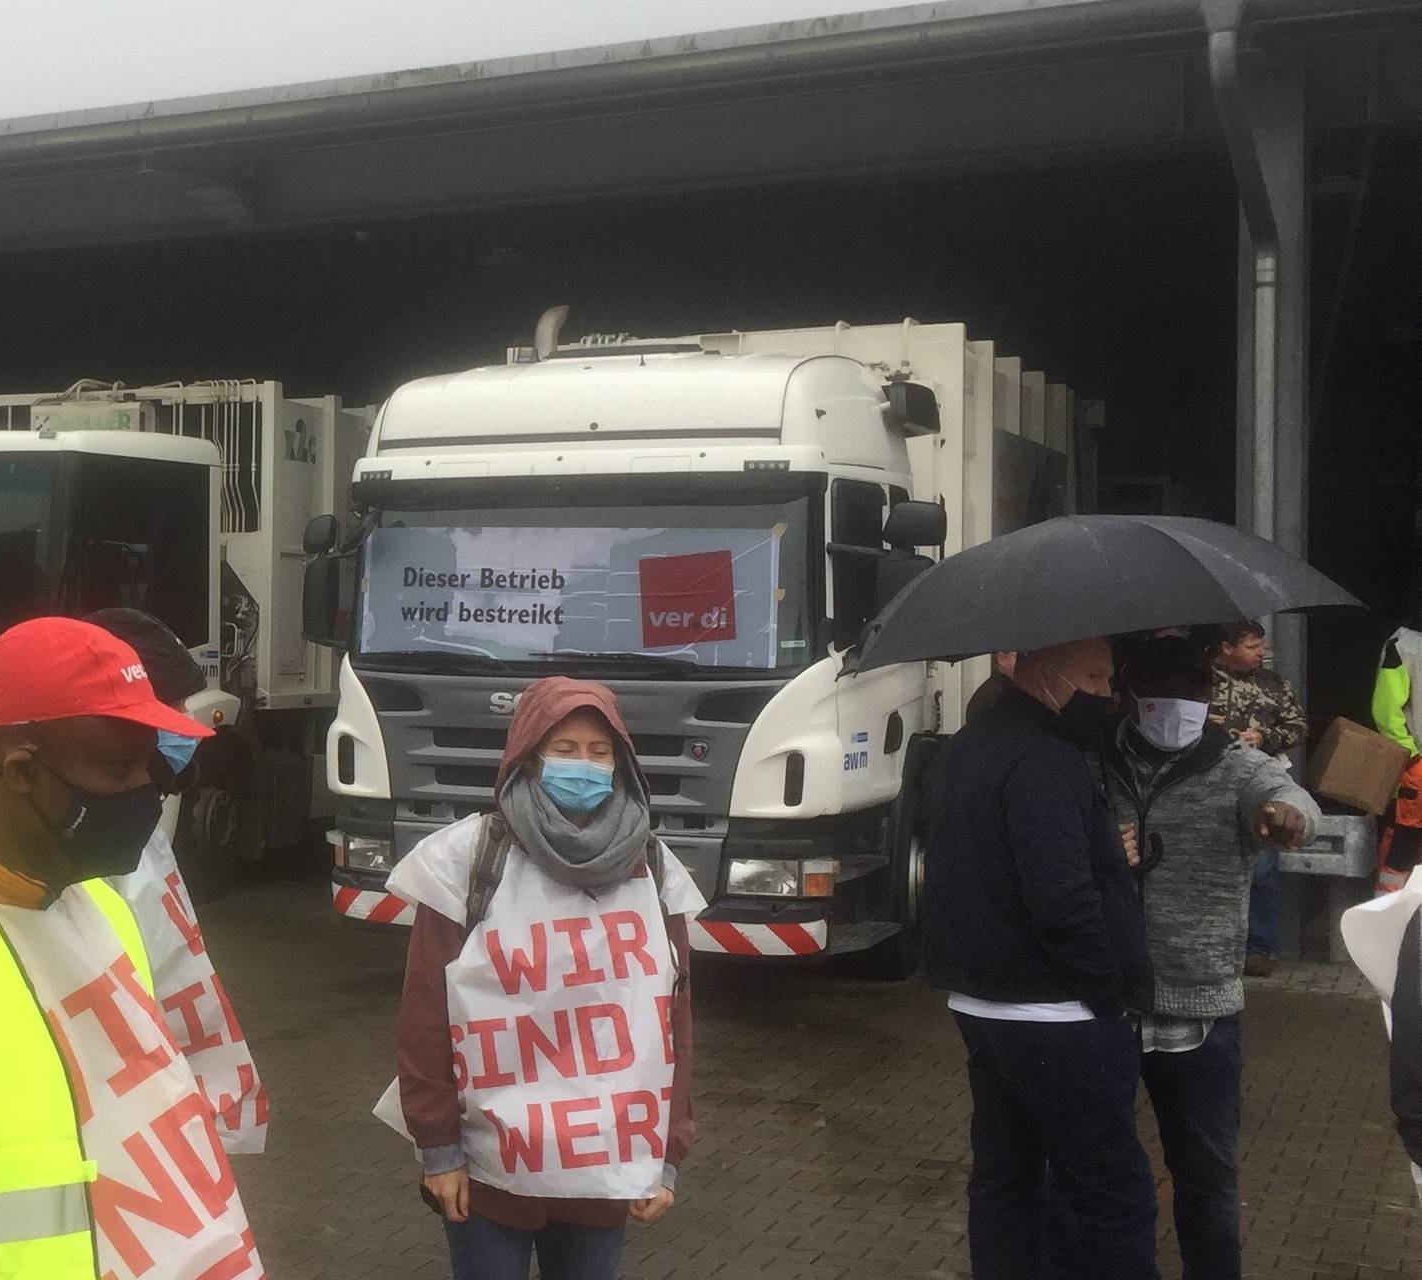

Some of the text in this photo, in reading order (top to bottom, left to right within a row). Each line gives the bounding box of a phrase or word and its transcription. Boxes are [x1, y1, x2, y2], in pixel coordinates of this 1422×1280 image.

[403, 566, 565, 590] Dieser Betrieb
[401, 600, 564, 625] wird bestreikt
[844, 751, 868, 771] awm
[486, 910, 658, 995] WIR
[482, 1087, 674, 1175] WER
